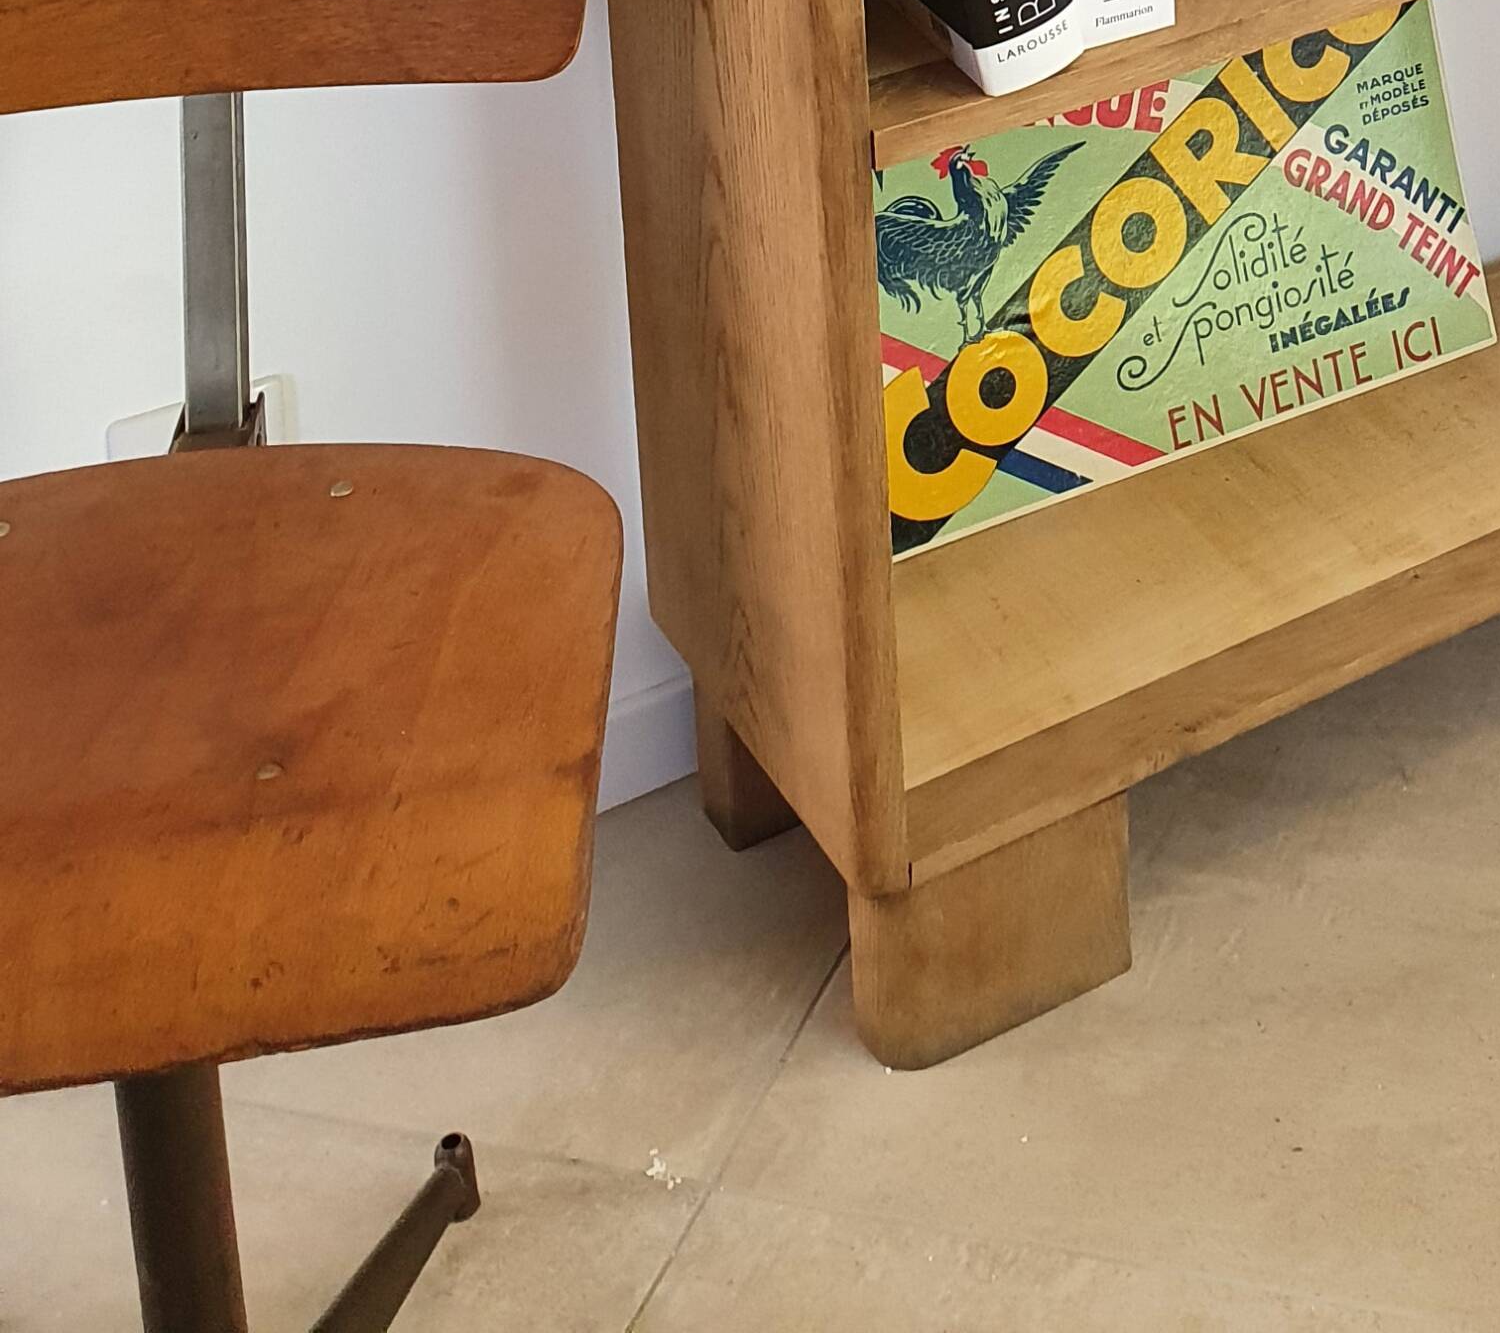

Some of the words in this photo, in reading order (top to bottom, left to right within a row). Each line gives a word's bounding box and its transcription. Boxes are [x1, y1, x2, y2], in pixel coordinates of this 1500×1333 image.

[1094, 3, 1154, 28] Flammarion
[996, 19, 1069, 64] LAROUSSE
[1356, 62, 1425, 94] MARQUE
[1369, 78, 1427, 106] MODÈLE
[1361, 94, 1430, 126] DÉPOSÉS
[1323, 123, 1466, 234] GARANTI
[1283, 148, 1396, 232] GRAND
[1397, 211, 1481, 299] TEINT
[1172, 211, 1308, 308] Solidité
[1142, 315, 1163, 347] et
[1268, 286, 1411, 353] INÉGALÉES
[1167, 393, 1225, 450] EN
[1239, 340, 1374, 422] VENTE
[1390, 315, 1443, 371] ICI
